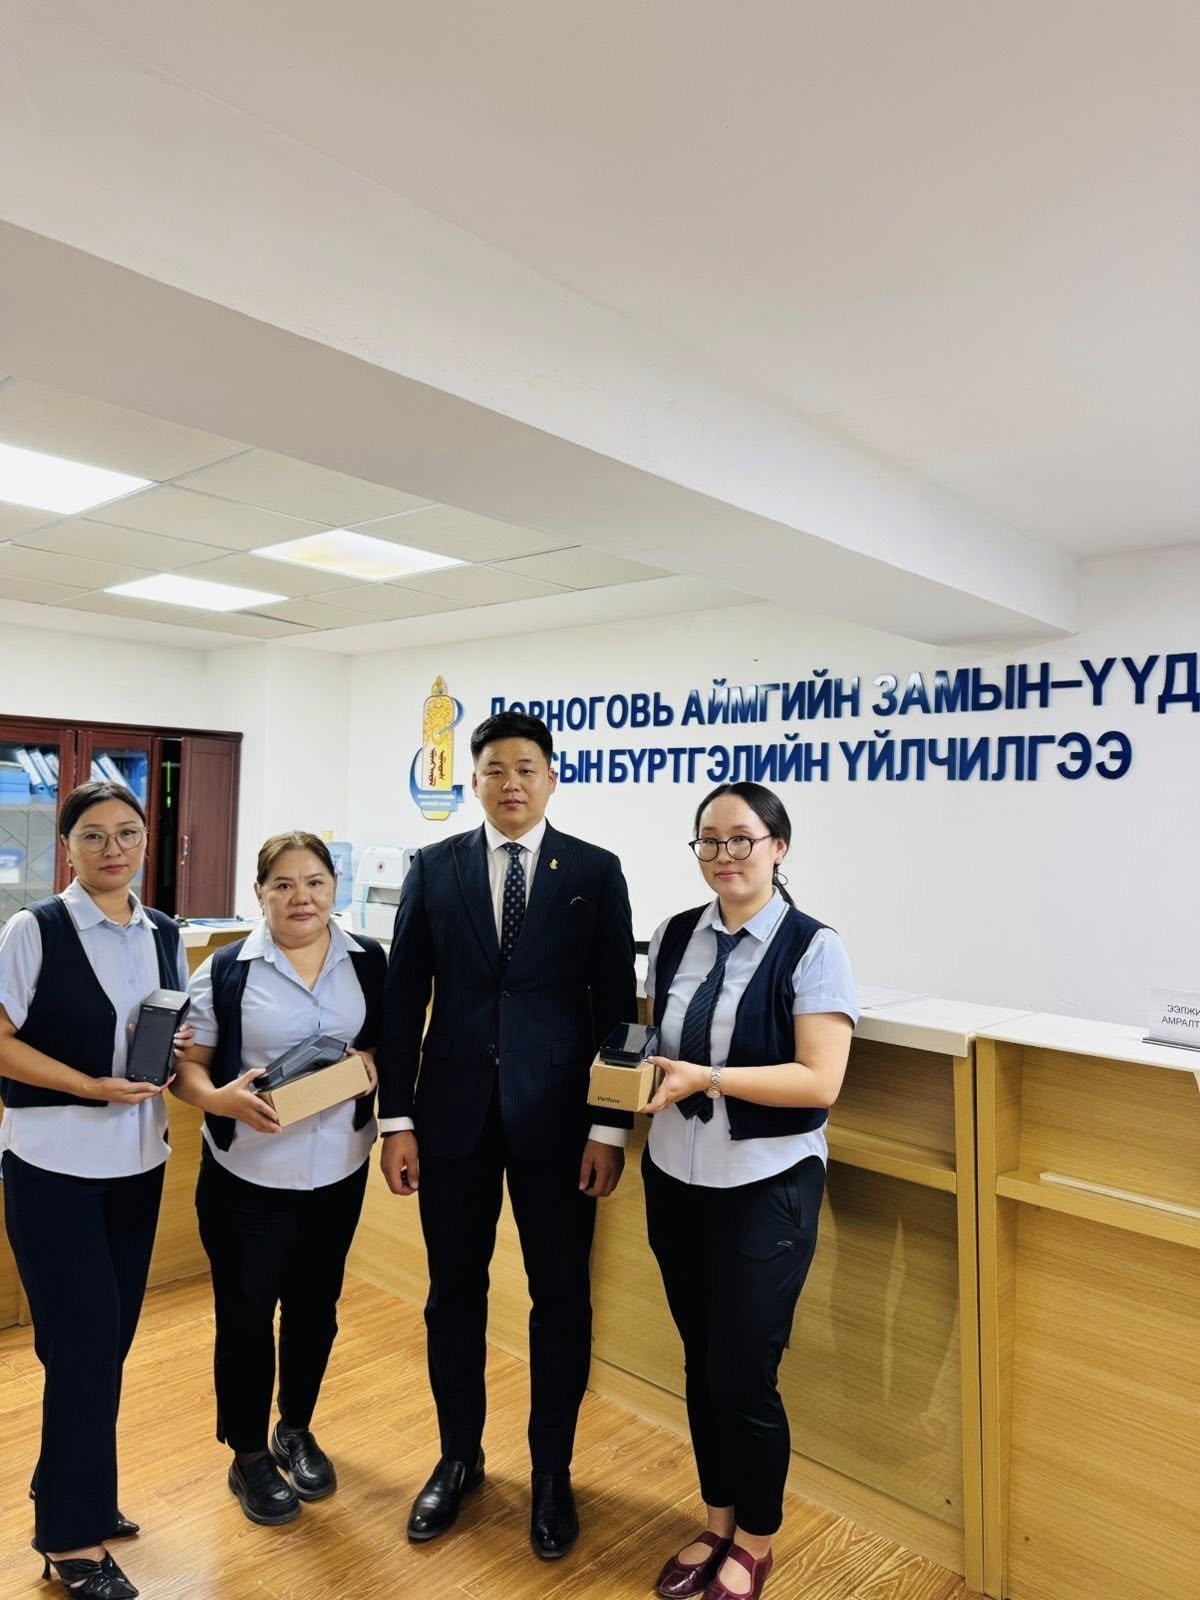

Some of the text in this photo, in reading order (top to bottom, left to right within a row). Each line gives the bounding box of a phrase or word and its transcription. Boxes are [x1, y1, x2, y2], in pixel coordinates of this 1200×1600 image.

[681, 669, 860, 726] АЙМГИЙН
[608, 733, 829, 783] БҮРТГЭЛИЙН
[838, 730, 1132, 781] ҮЙЛЧИЛГЭЭ
